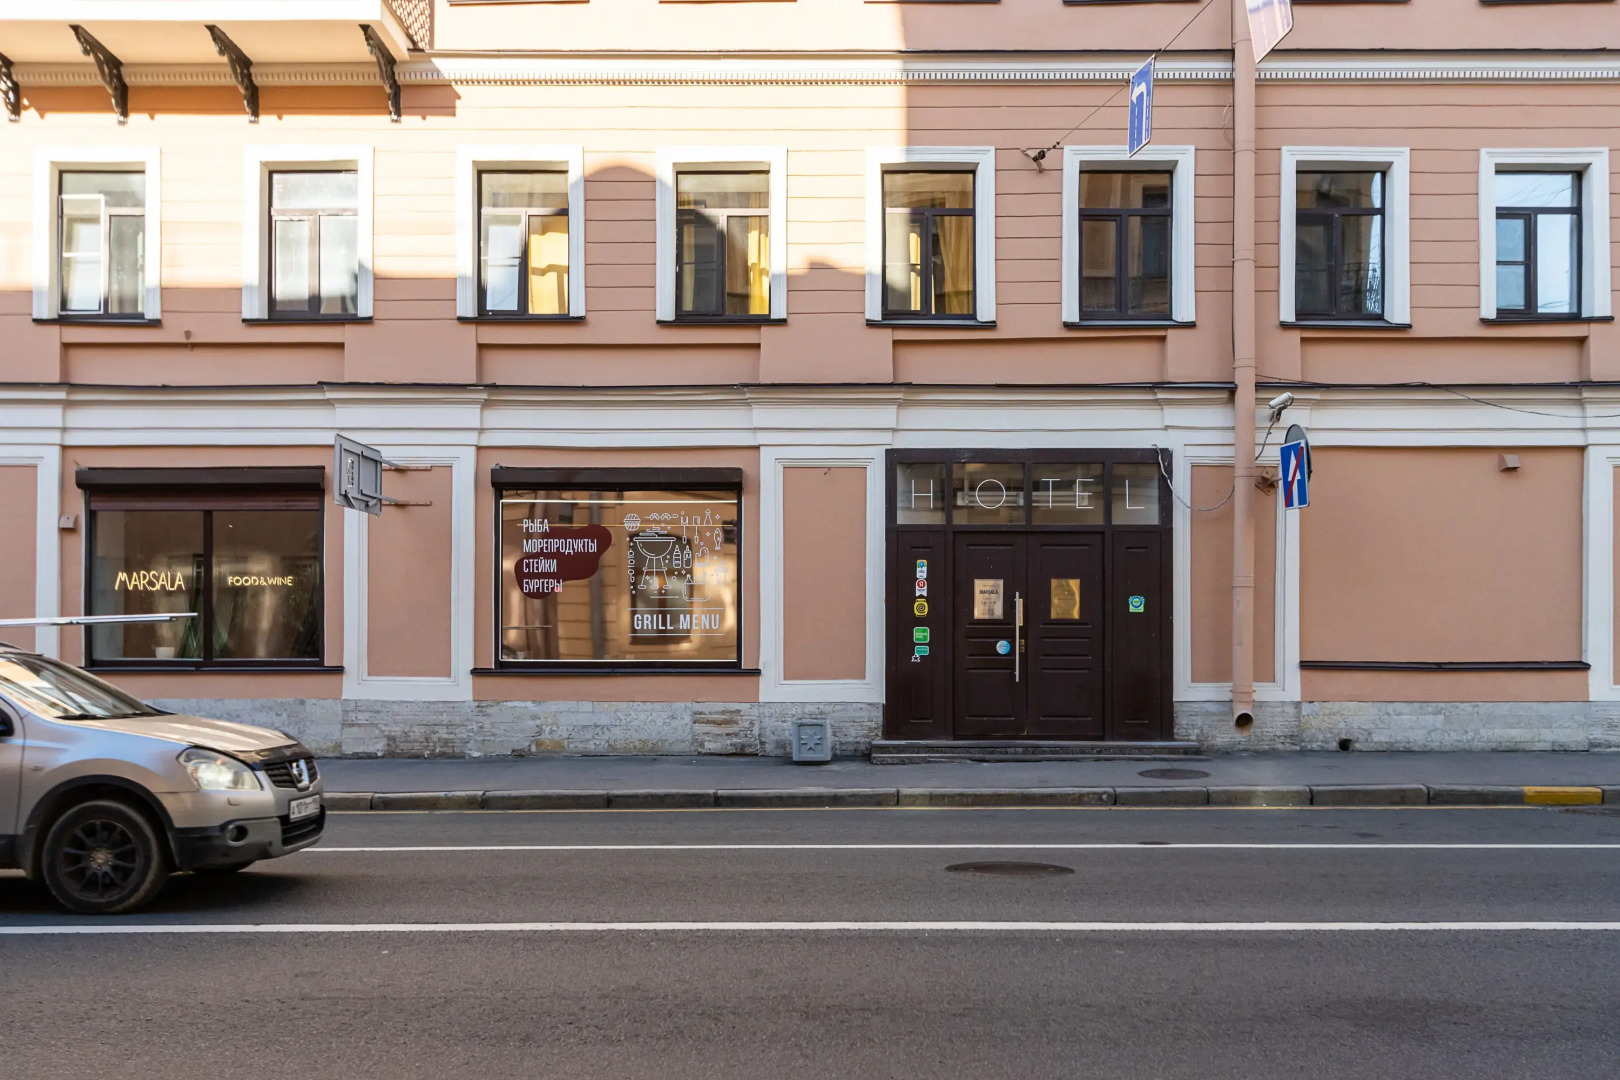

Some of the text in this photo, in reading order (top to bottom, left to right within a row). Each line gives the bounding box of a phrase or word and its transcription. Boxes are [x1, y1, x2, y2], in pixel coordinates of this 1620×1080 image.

[911, 478, 1145, 509] HOTEL
[523, 519, 550, 533] РЫБА
[523, 538, 597, 556] МОРЕПРОДУКТЫ
[523, 556, 557, 573] СТЕЙКИ
[114, 570, 186, 591] MARSALA
[523, 578, 563, 593] БУРГЕРЫ
[633, 613, 720, 630] GRILL MENU
